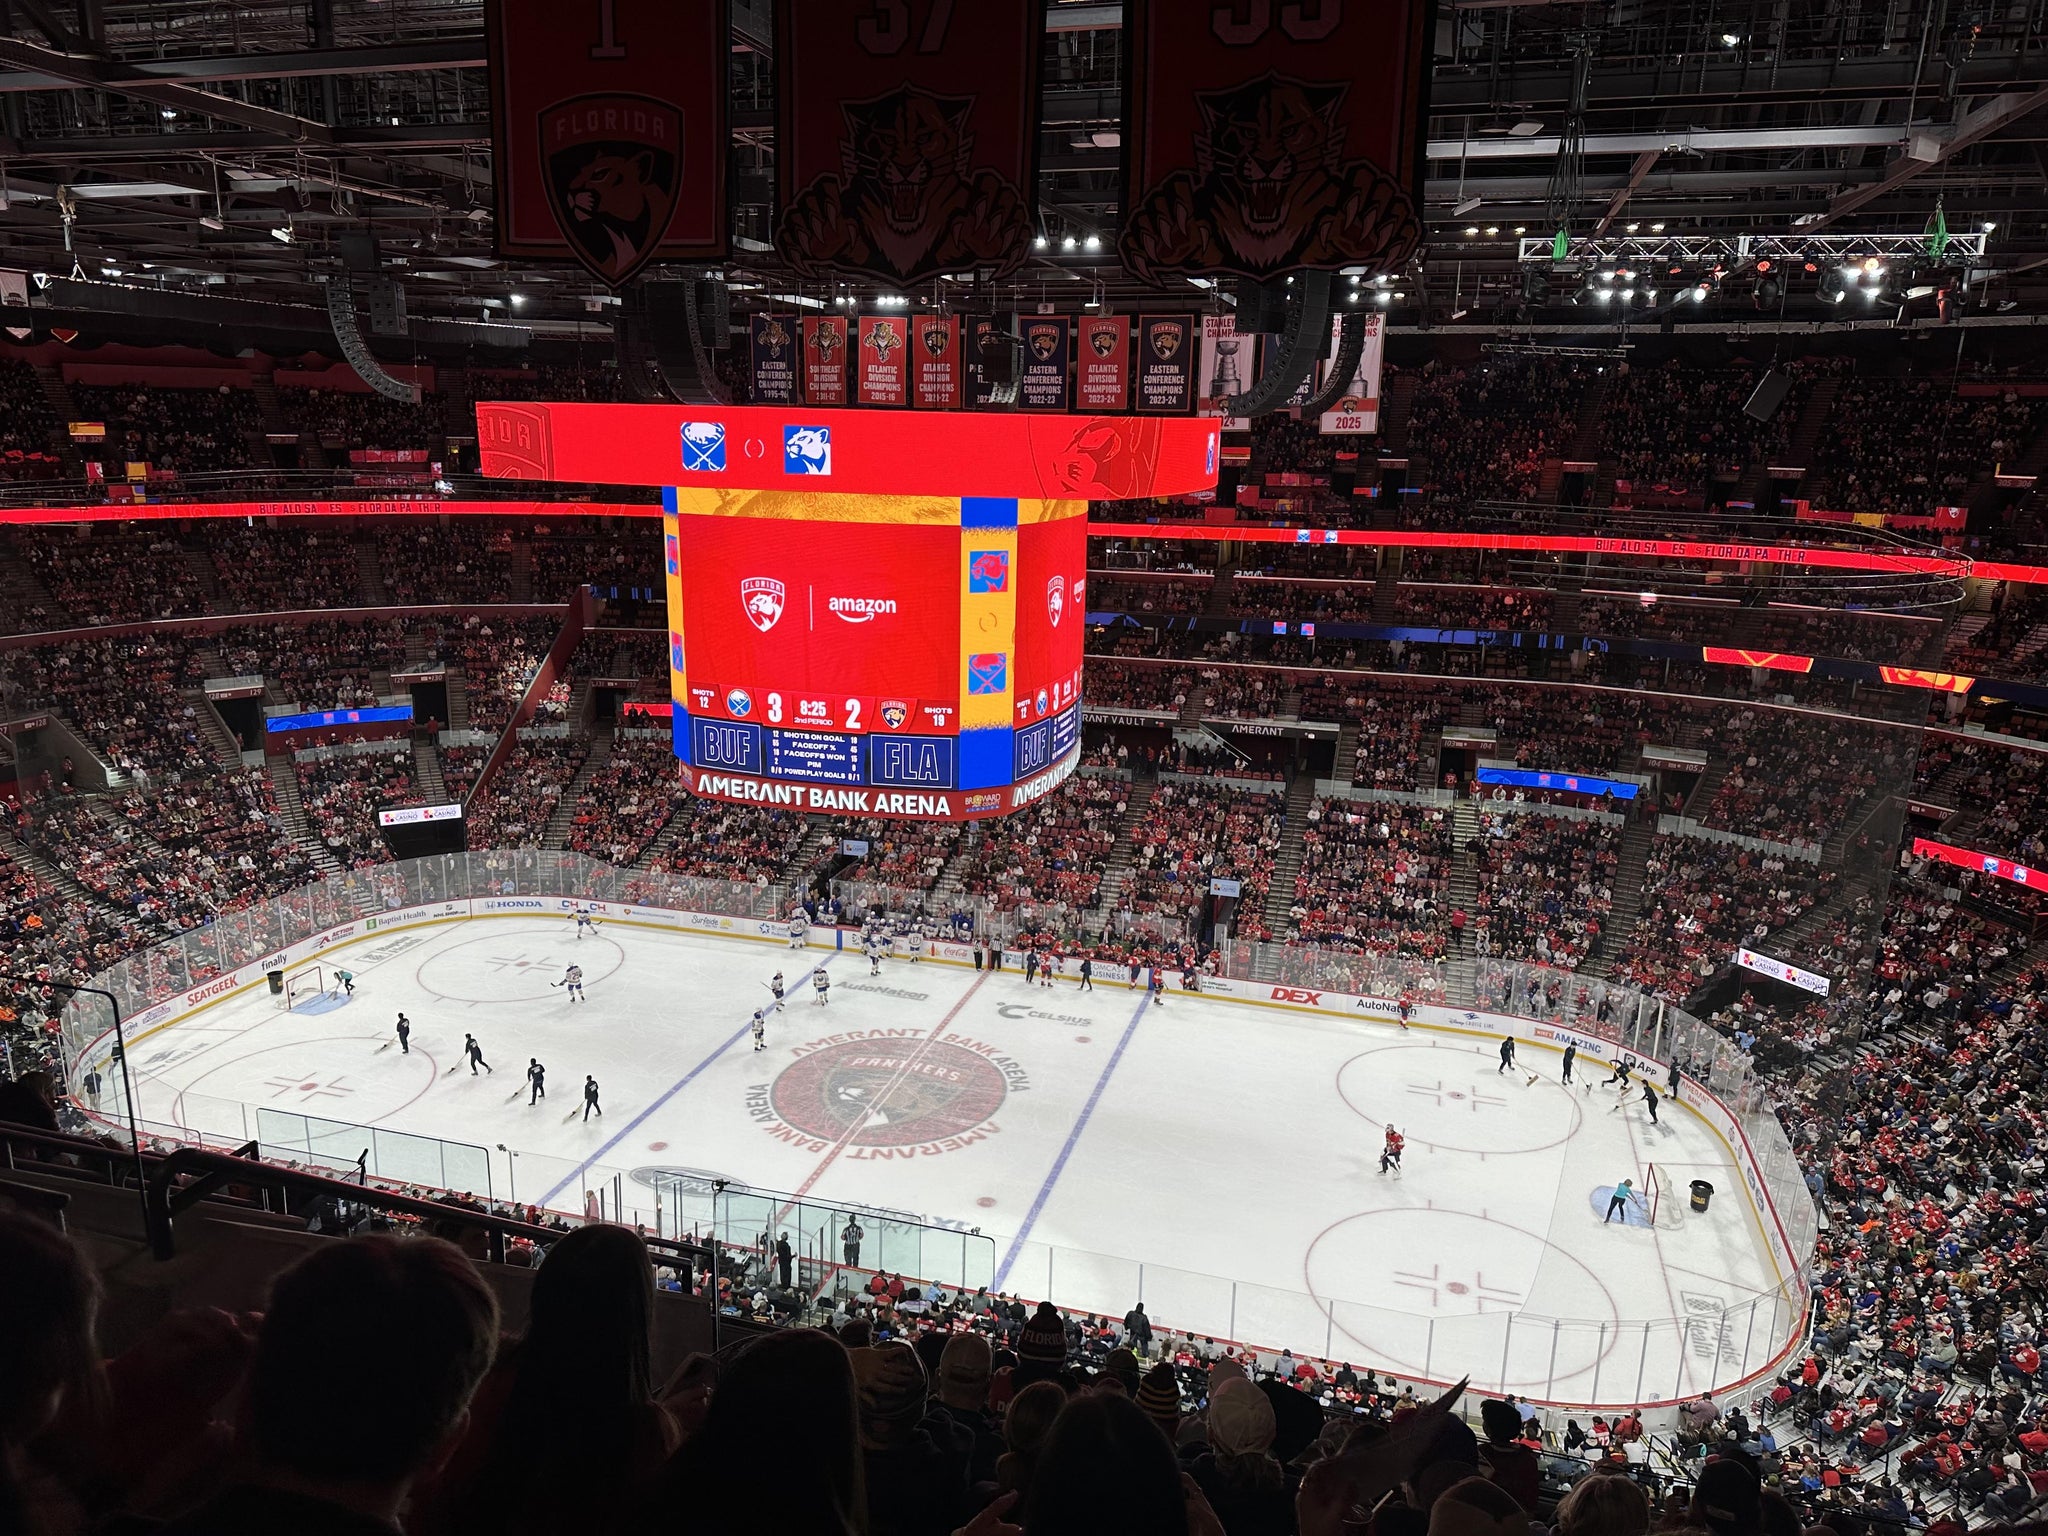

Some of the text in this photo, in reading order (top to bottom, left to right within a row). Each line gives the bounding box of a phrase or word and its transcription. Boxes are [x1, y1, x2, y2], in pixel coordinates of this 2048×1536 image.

[556, 108, 665, 141] FLORIDA
[1205, 318, 1236, 328] STANLEY
[867, 365, 898, 374] ATLANTIC
[1029, 365, 1057, 375] EASTERN
[1087, 364, 1119, 374] ATLANTIC
[1149, 364, 1180, 374] EASTERN
[868, 374, 897, 383] DIVISION
[1023, 375, 1063, 385] CONFERENCE
[1088, 374, 1117, 384] DIVISION
[1143, 375, 1185, 385] CONFERENCE
[863, 382, 901, 392] CHAMPIONS
[1023, 384, 1062, 394] CHAMPIONS
[1082, 384, 1122, 394] CHAMPIONS
[1143, 385, 1184, 395] CHAMPIONS
[871, 391, 896, 401] 2015-16
[1028, 395, 1056, 404] 2022-23
[1088, 395, 1116, 404] 2023-24
[1149, 396, 1177, 405] 2023-24
[1335, 416, 1362, 430] 2025
[745, 581, 782, 592] FLORIDA
[829, 597, 897, 616] amazon
[249, 688, 262, 697] 129
[692, 688, 715, 697] SHOTS
[1053, 682, 1060, 711] 3
[699, 696, 709, 708] 12
[767, 692, 783, 723] 3
[800, 699, 826, 717] 8:25
[845, 698, 861, 729] 2
[924, 706, 953, 714] SHOTS
[1020, 706, 1028, 719] 12
[1111, 715, 1146, 727] VAULT
[1231, 724, 1284, 737] AMERANT
[784, 731, 810, 740] SHOTS
[822, 735, 846, 743] GOAL
[703, 725, 750, 766] BUF
[792, 741, 829, 751] FACEOFF
[1021, 727, 1047, 772] BUF
[784, 750, 826, 760] FACEOFFS
[826, 753, 846, 761] WON
[884, 742, 939, 781] FLA
[784, 767, 806, 777] POWER
[806, 769, 824, 778] PLAY
[823, 771, 846, 780] GOALS
[1012, 763, 1064, 807] AMERANT
[698, 774, 951, 816] AMERANT BANK ARENA
[562, 900, 579, 909] CH
[590, 903, 607, 912] CH
[378, 910, 427, 927] Baptist Health
[332, 926, 355, 938] ACTION
[261, 953, 288, 971] finally
[1754, 960, 1780, 974] CASINO
[187, 974, 239, 1007] SEATGEEK
[834, 981, 930, 1001] AutoNation
[1270, 987, 1323, 1006] DEX
[1028, 1010, 1093, 1025] CELSIUS
[1554, 1032, 1602, 1054] AMAZING
[790, 1027, 1031, 1093] AMERANT BANK ARENA
[1680, 1080, 1711, 1105] AMERANT
[746, 1083, 1002, 1160] AMERANT BANK ARENA
